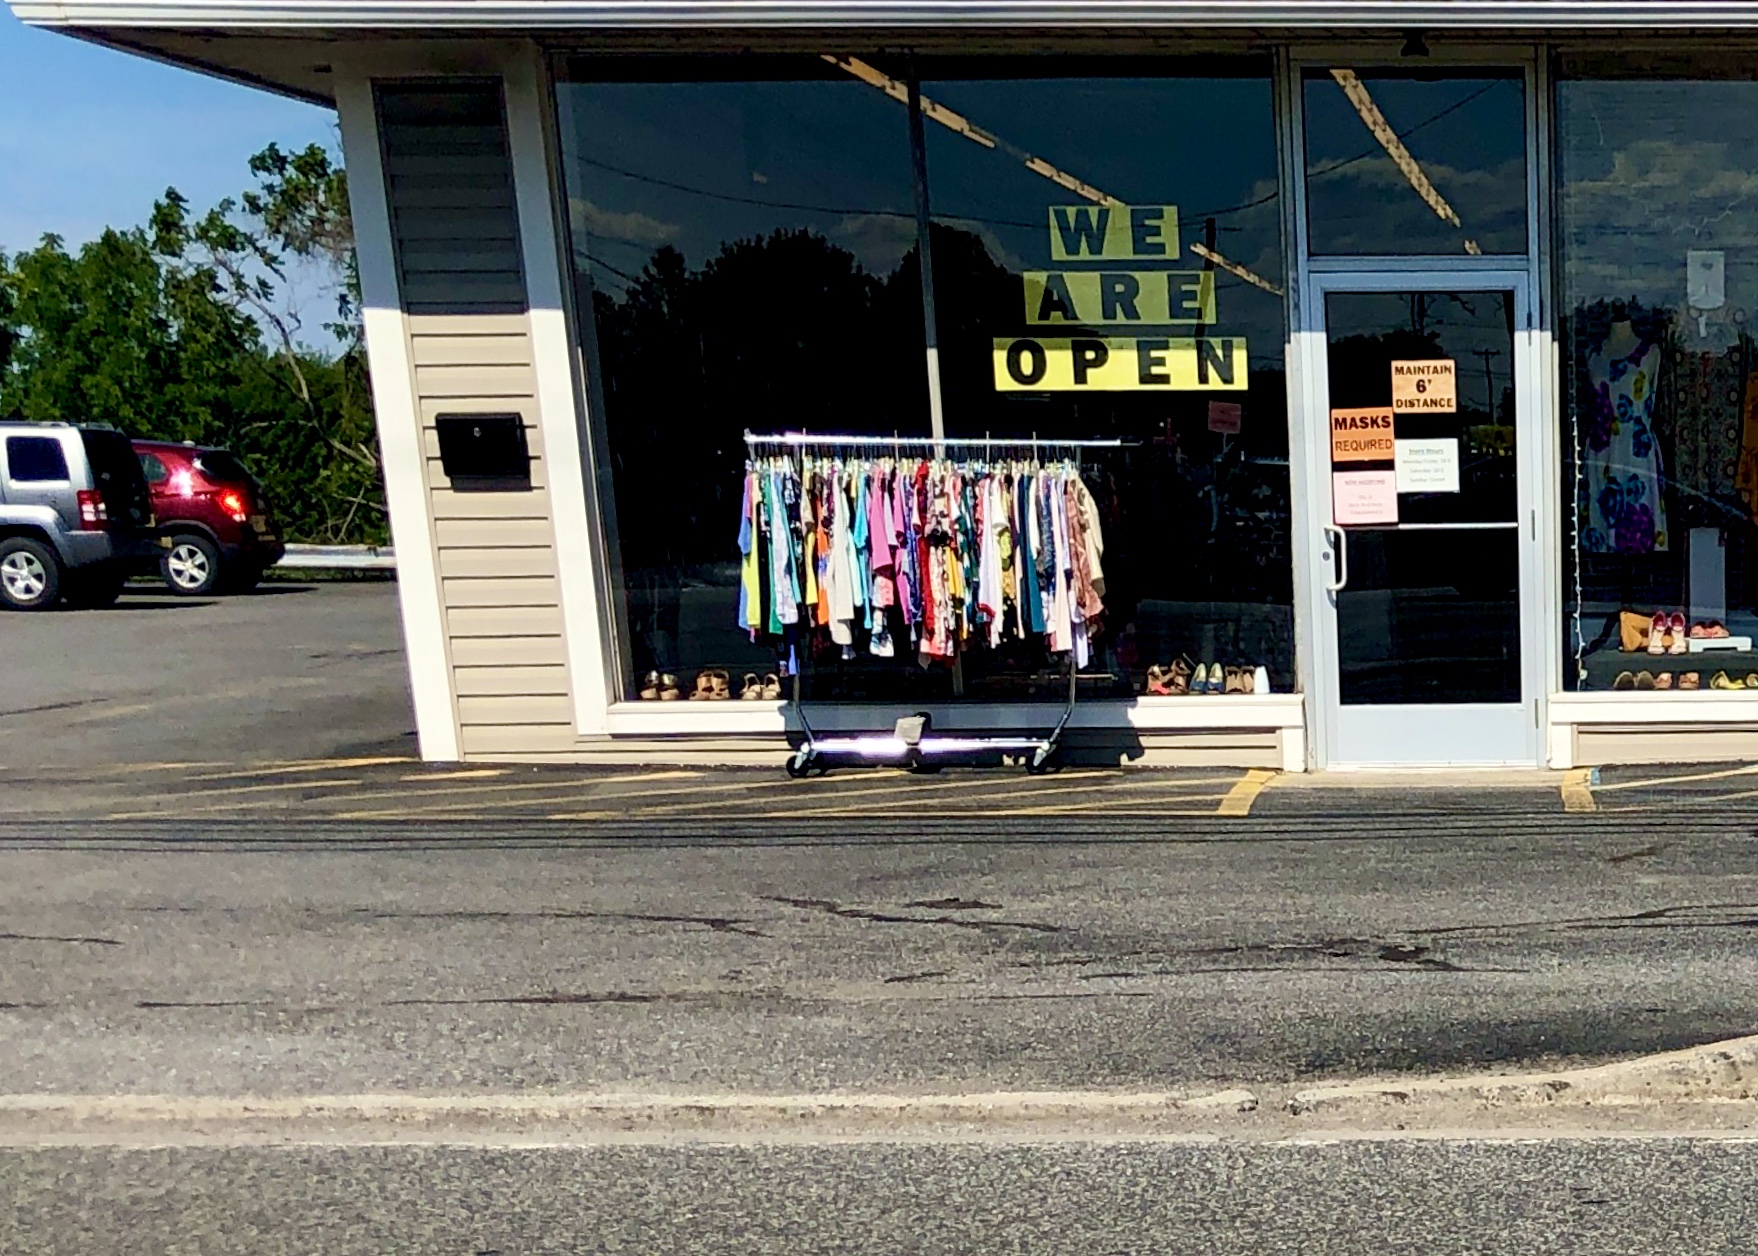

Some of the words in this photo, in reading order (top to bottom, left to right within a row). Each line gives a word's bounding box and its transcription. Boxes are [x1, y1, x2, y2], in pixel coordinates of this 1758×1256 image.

[1054, 208, 1167, 255] WE
[1037, 273, 1203, 321] ARE
[1006, 338, 1235, 386] OPEN
[1394, 365, 1452, 376] MAINTAIN
[1395, 397, 1453, 409] DISTANCE
[1334, 415, 1391, 431] MASKS
[1335, 438, 1393, 452] REQUIRED
